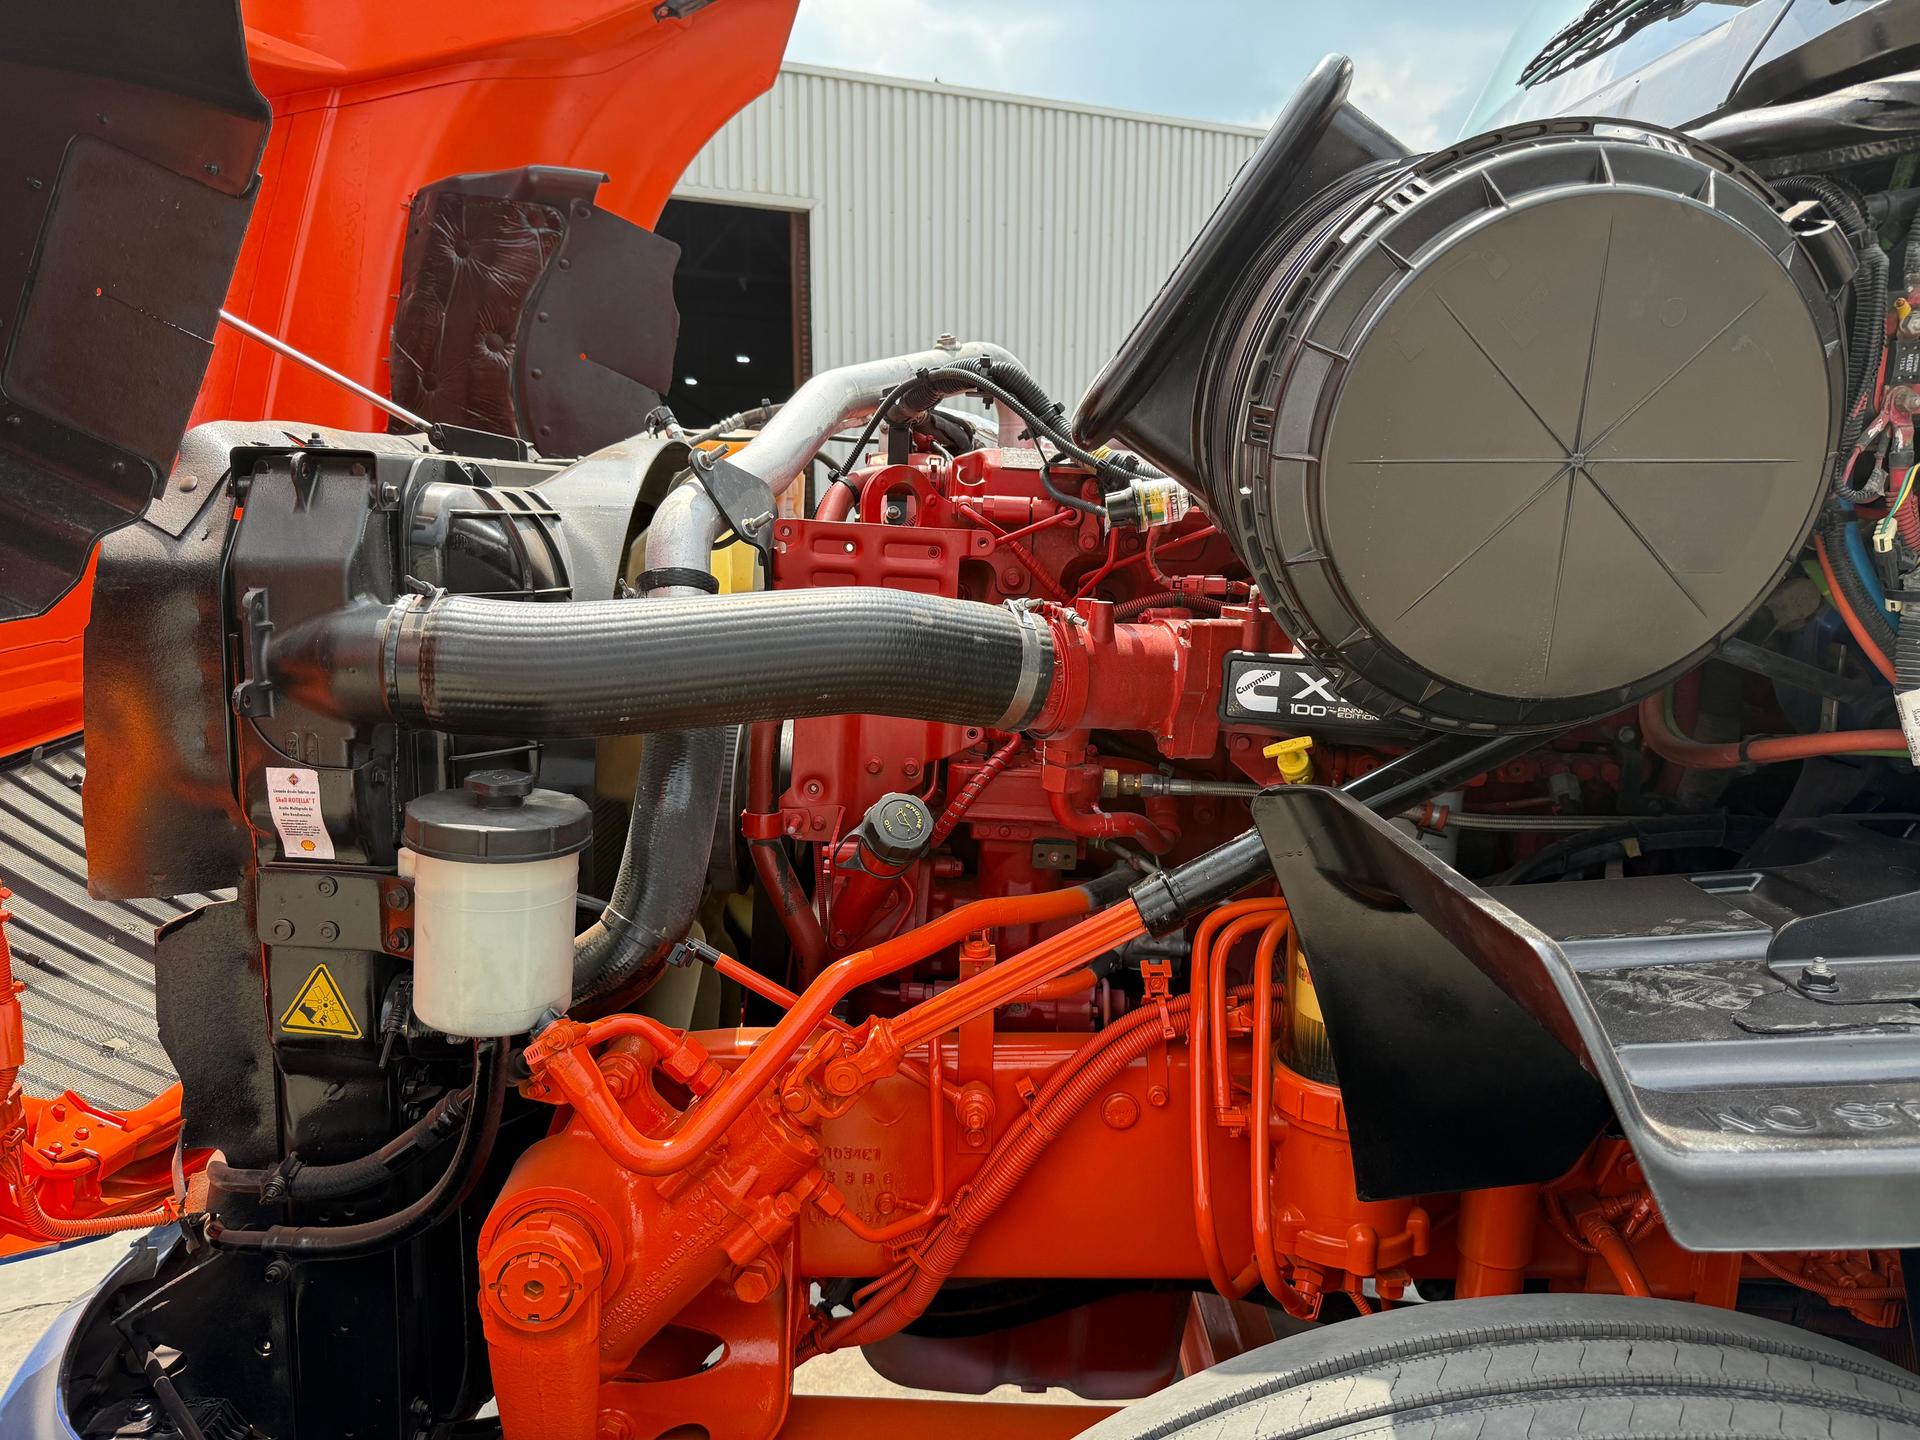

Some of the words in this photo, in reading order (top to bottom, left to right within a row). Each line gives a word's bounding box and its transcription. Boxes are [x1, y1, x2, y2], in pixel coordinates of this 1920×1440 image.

[1236, 670, 1277, 695] Cummins
[1336, 713, 1380, 721] EDITION
[883, 819, 894, 832] OIL
[905, 803, 923, 830] ENGINE
